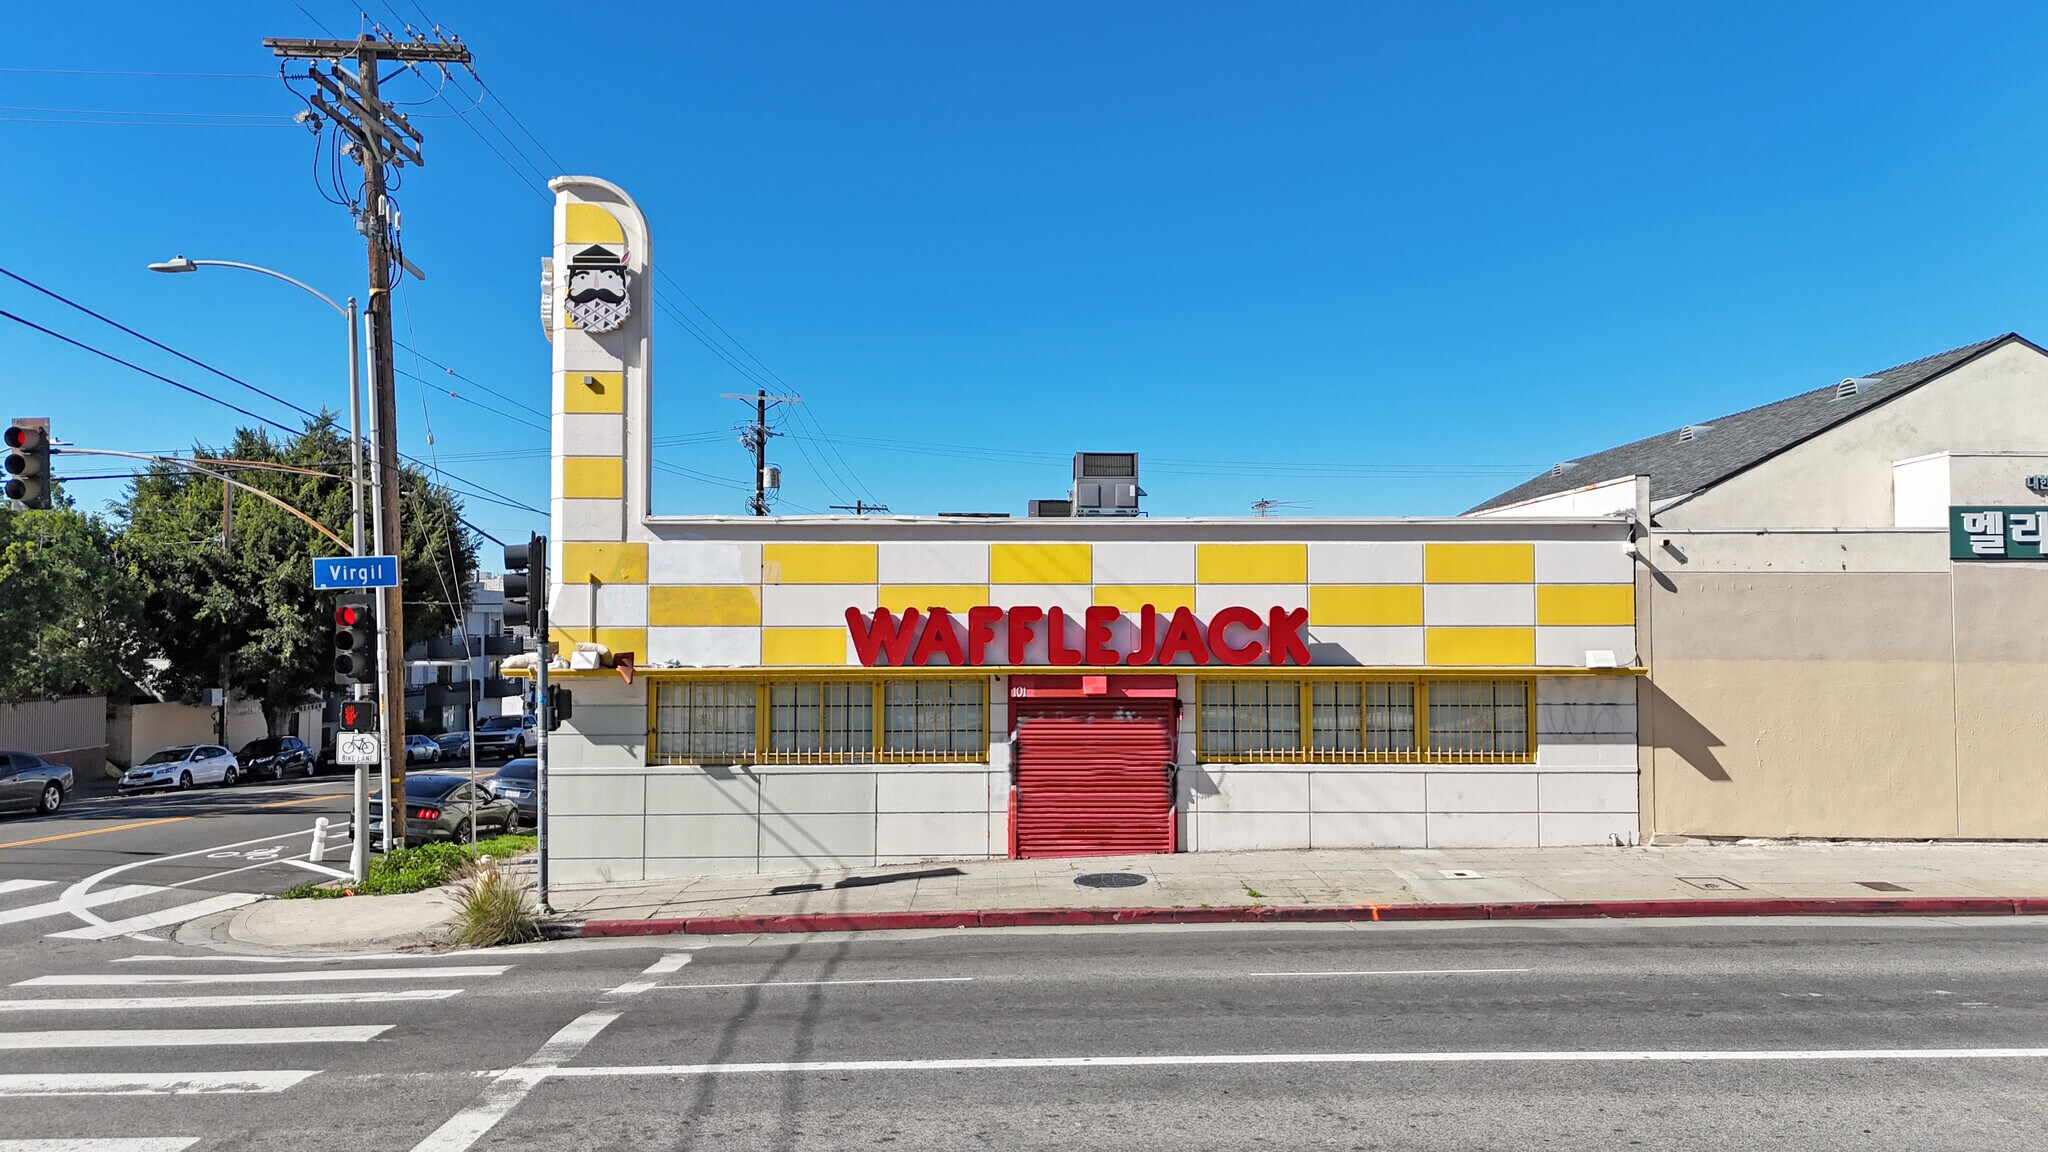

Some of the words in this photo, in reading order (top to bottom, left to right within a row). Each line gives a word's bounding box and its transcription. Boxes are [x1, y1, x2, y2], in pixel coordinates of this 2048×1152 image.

[329, 564, 382, 585] Virgil
[845, 603, 1312, 667] WAFFLEJACK
[1012, 686, 1027, 698] 101
